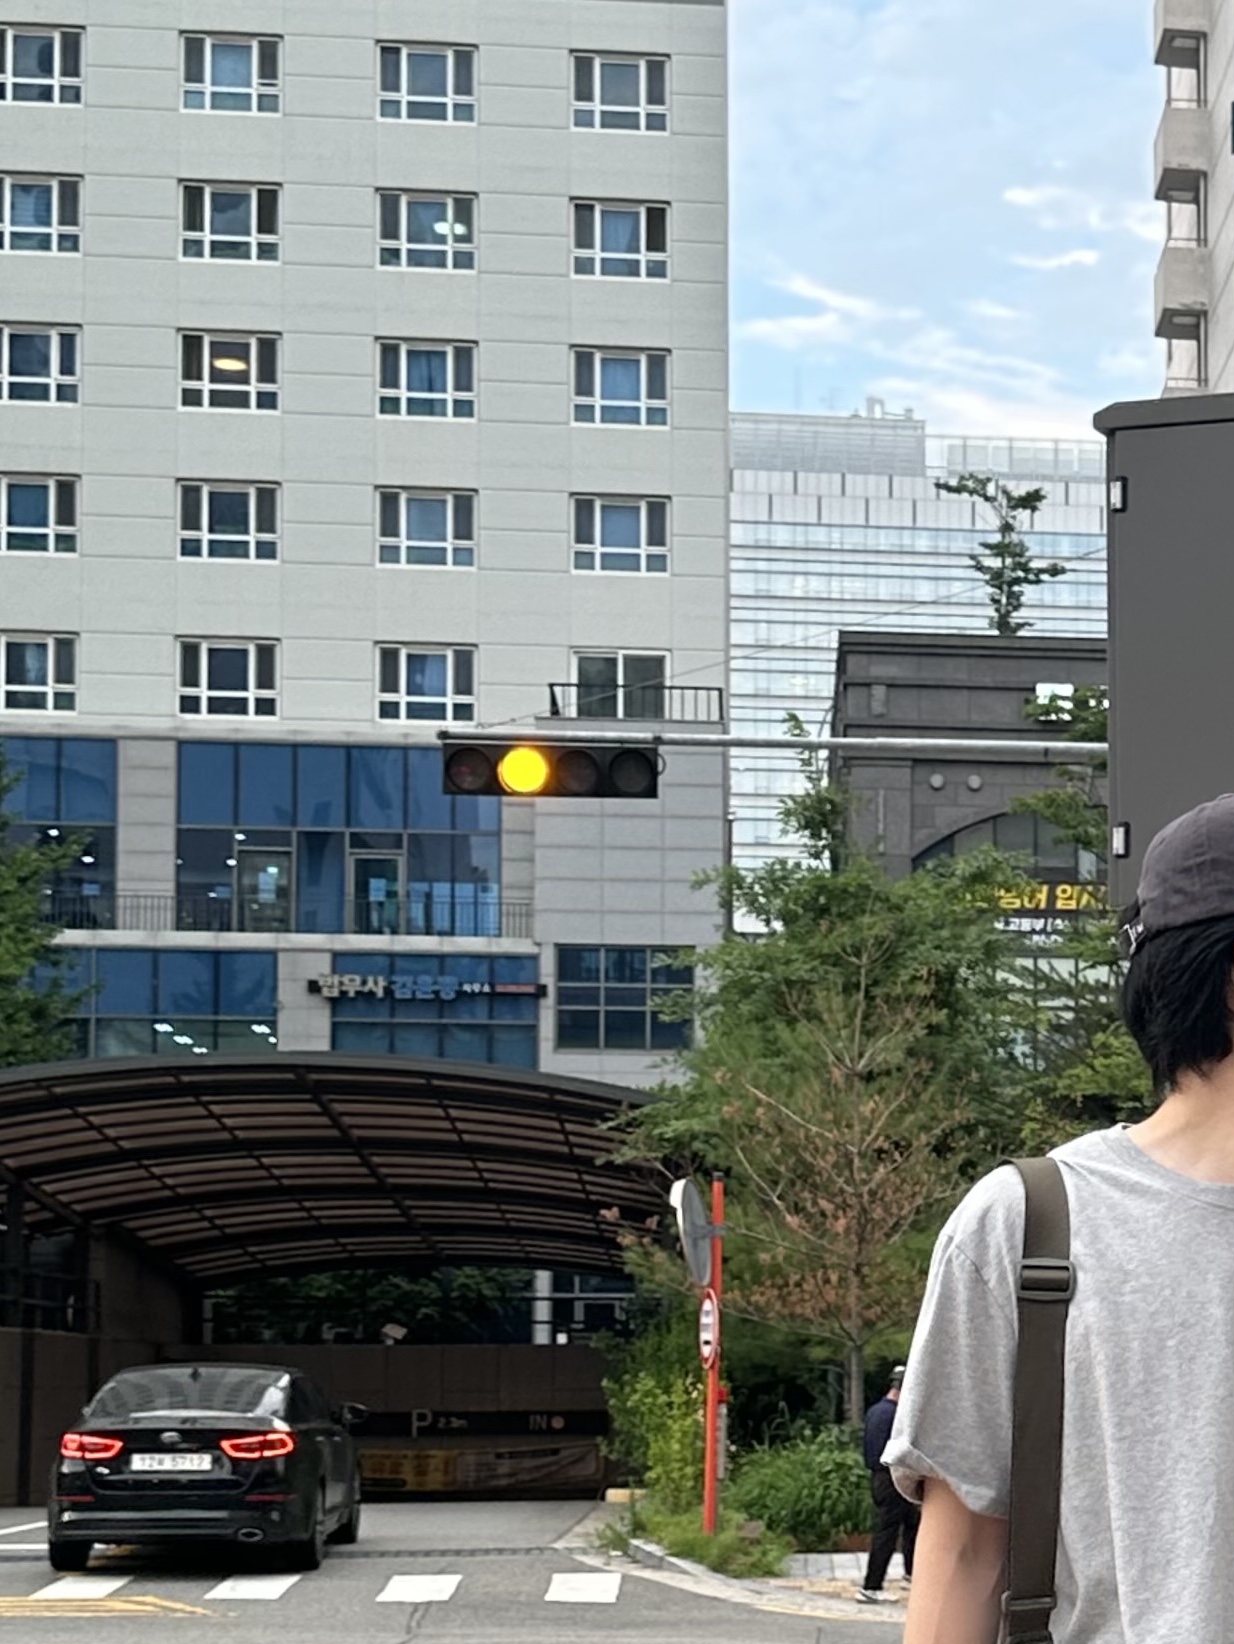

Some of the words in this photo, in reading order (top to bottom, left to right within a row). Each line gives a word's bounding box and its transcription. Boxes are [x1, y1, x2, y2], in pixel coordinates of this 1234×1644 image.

[319, 974, 388, 998] 법무사
[412, 1409, 432, 1438] P
[529, 1415, 548, 1431] IN
